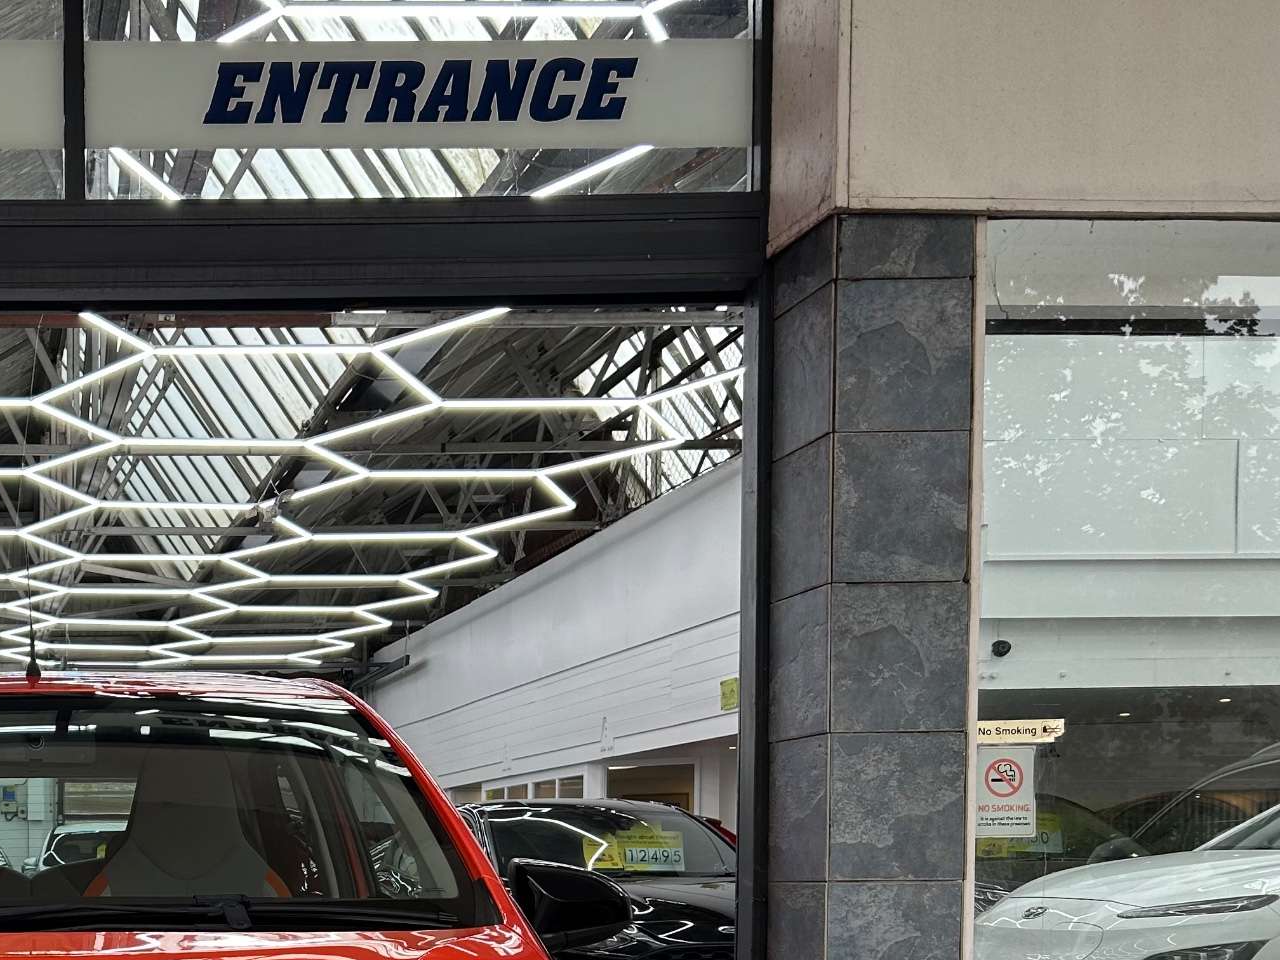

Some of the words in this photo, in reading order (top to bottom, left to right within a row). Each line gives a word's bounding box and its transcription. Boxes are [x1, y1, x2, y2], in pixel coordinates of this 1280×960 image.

[202, 56, 639, 124] ENTRANCE
[978, 727, 992, 736] No
[995, 727, 1037, 736] Smoking
[978, 804, 990, 812] NO
[628, 850, 682, 862] 12495
